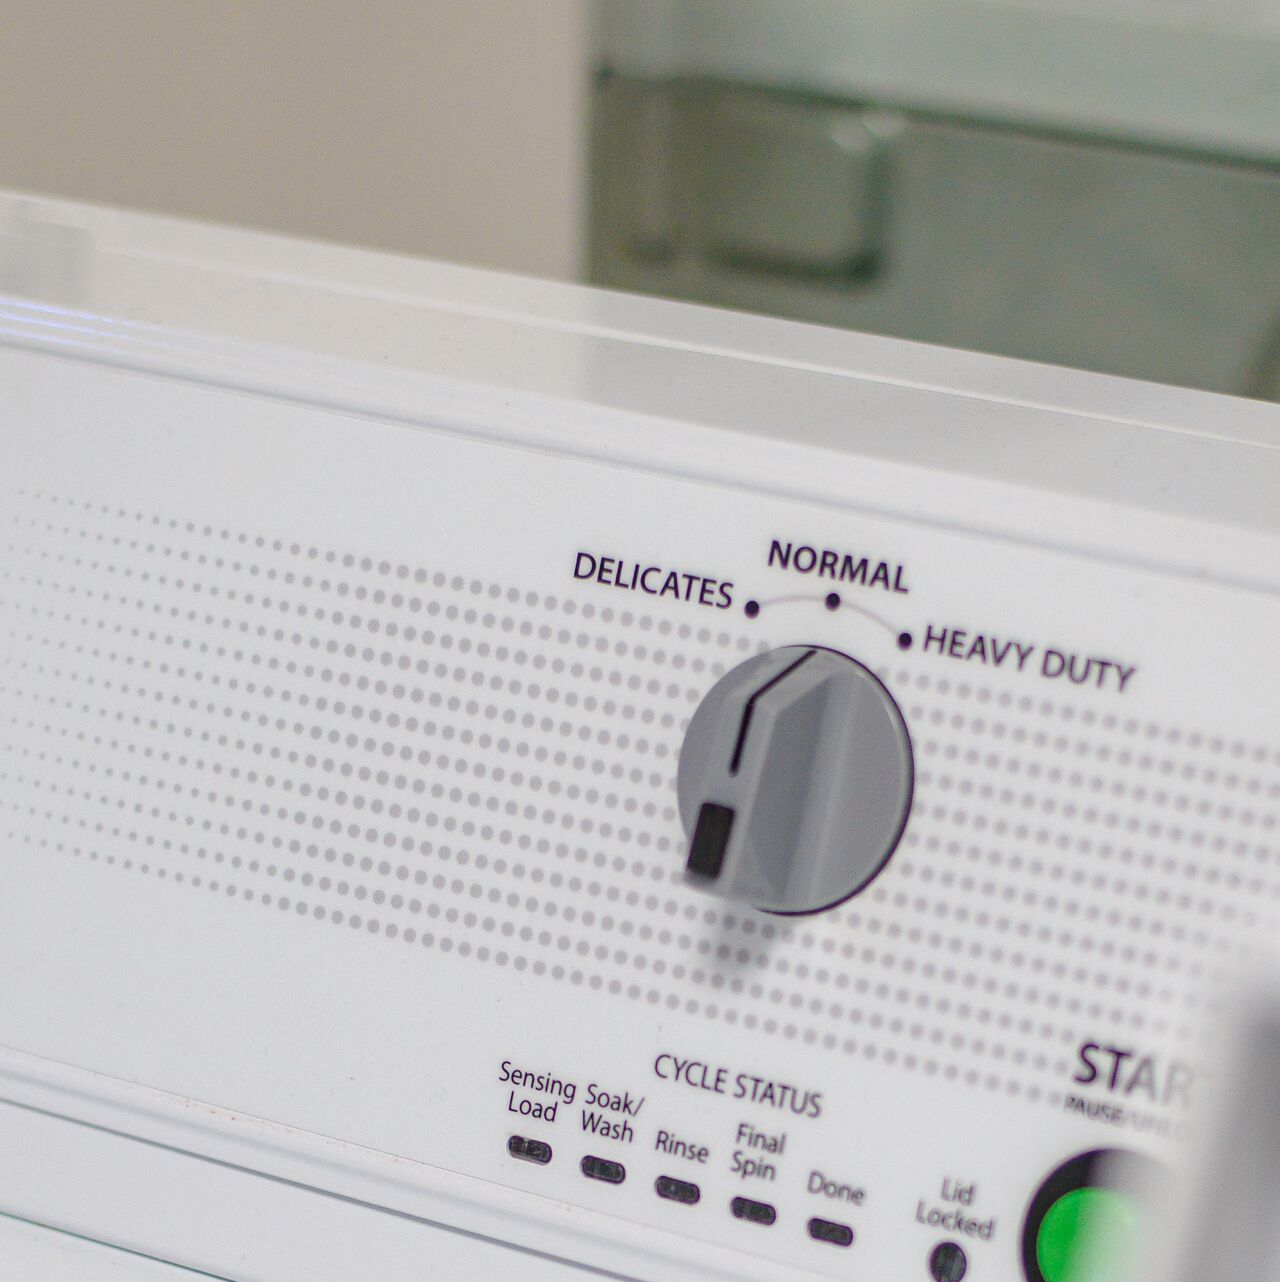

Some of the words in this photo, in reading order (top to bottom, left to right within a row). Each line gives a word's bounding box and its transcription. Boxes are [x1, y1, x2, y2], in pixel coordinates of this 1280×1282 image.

[573, 551, 734, 611] DELICATES
[767, 540, 908, 594] NORMAL
[924, 624, 1034, 671] HEAVY
[1041, 649, 1137, 693] DUTY
[499, 1060, 577, 1104] Sensing
[654, 1053, 728, 1095] CYCLE
[733, 1073, 823, 1119] STATUS
[508, 1091, 558, 1122] Load
[585, 1083, 645, 1117] Soak/
[582, 1110, 634, 1143] Wash
[736, 1123, 787, 1155] Final
[656, 1130, 709, 1163] Rinse
[731, 1150, 776, 1182] Spin
[807, 1171, 866, 1206] Done
[941, 1176, 976, 1206] Lid
[916, 1198, 995, 1241] Locked
